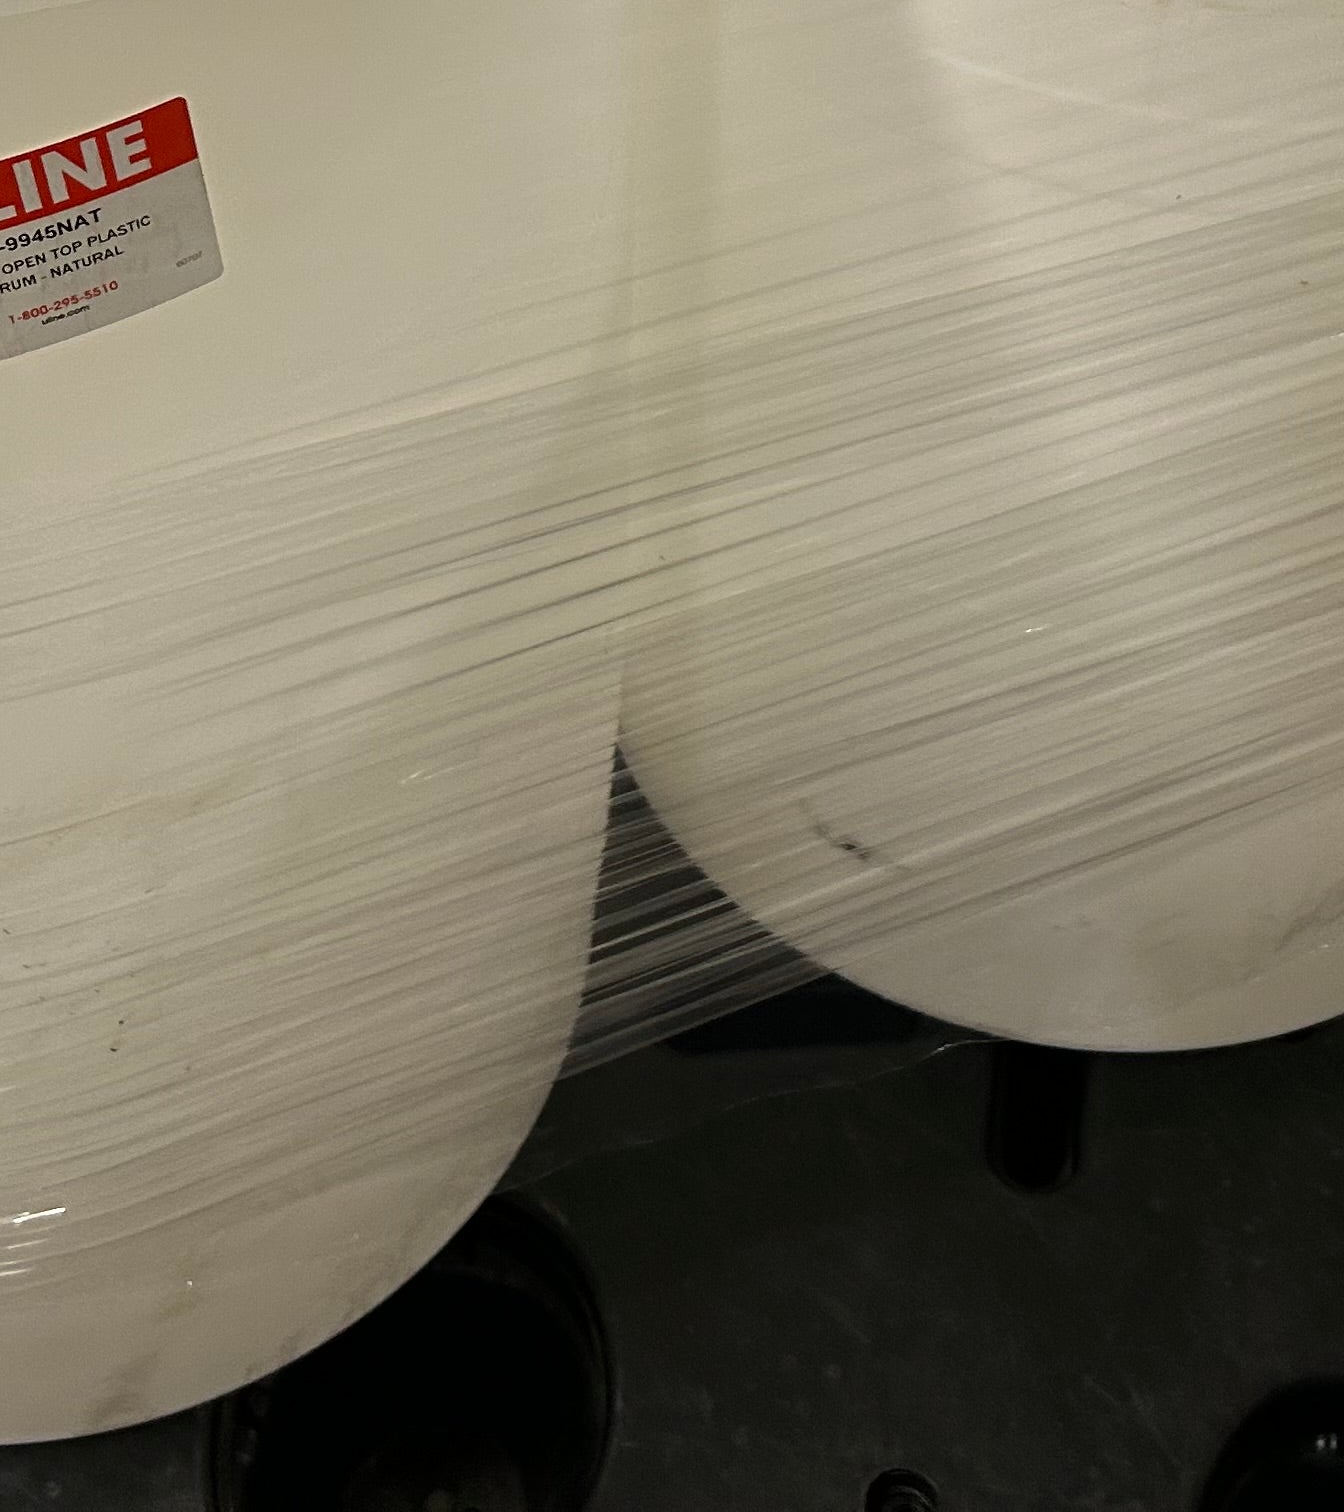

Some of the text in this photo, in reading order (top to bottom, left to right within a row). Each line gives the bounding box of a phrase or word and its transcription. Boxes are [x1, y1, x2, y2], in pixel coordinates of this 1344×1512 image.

[1, 252, 47, 275] OPEN
[49, 240, 83, 260] TOP
[87, 215, 152, 248] PLASTIC
[49, 245, 125, 279] NATURAL
[8, 280, 119, 324] 1-800-295-5510
